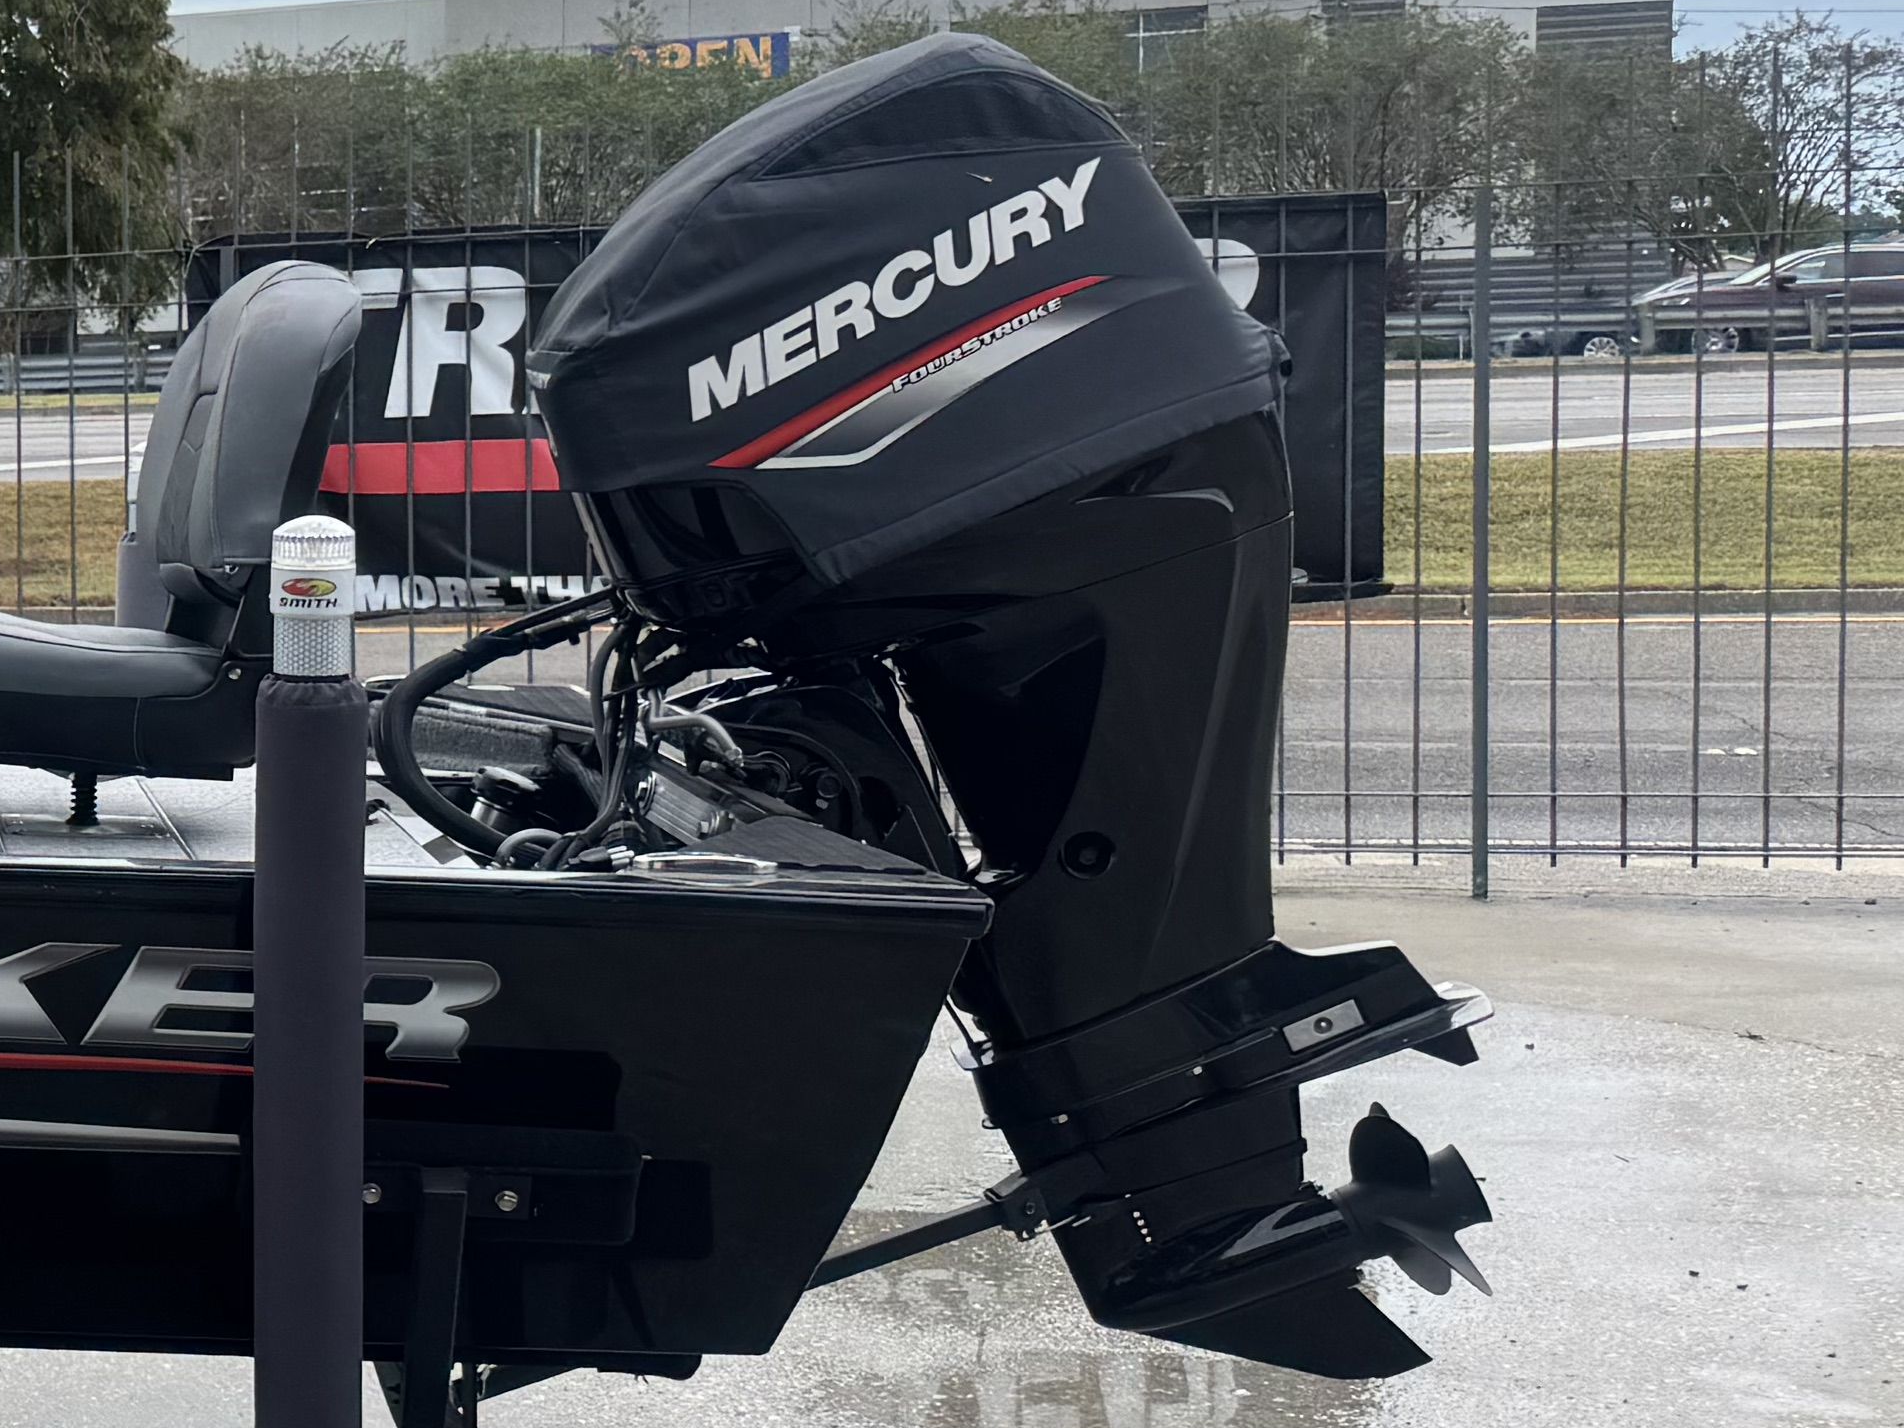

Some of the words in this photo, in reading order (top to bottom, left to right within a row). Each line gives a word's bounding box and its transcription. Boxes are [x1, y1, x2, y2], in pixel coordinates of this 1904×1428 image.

[688, 156, 1102, 423] MERCURY
[892, 296, 1063, 394] FOURSTROKE
[279, 596, 338, 609] SMITH
[354, 574, 506, 611] MORE
